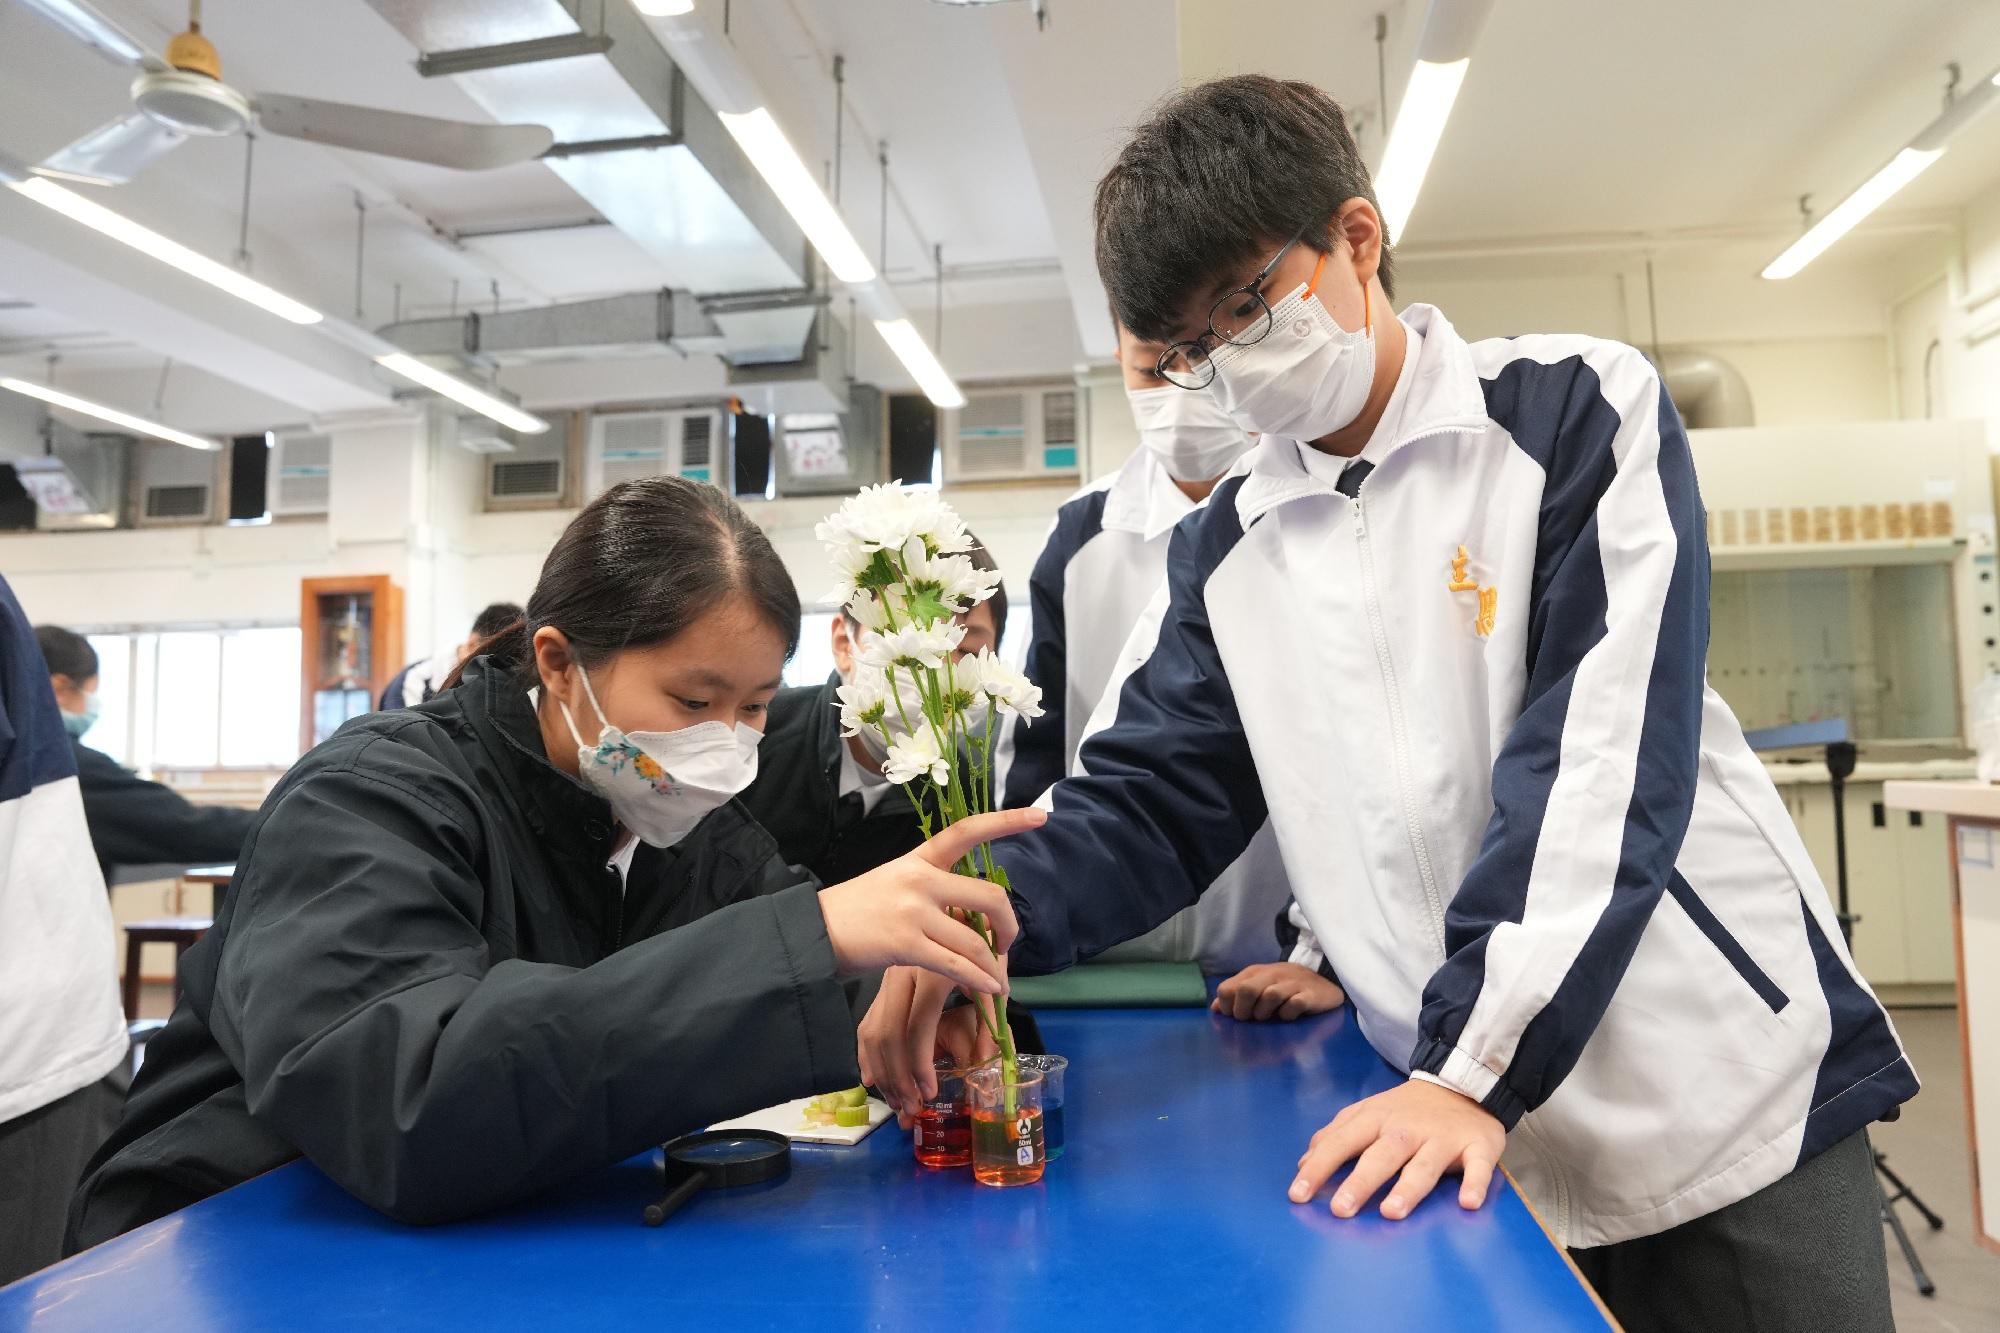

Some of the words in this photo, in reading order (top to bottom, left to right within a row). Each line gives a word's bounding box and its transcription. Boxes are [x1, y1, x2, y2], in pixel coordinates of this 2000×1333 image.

[935, 1116, 944, 1124] 30
[936, 1130, 945, 1138] 20
[1020, 1147, 1031, 1163] A
